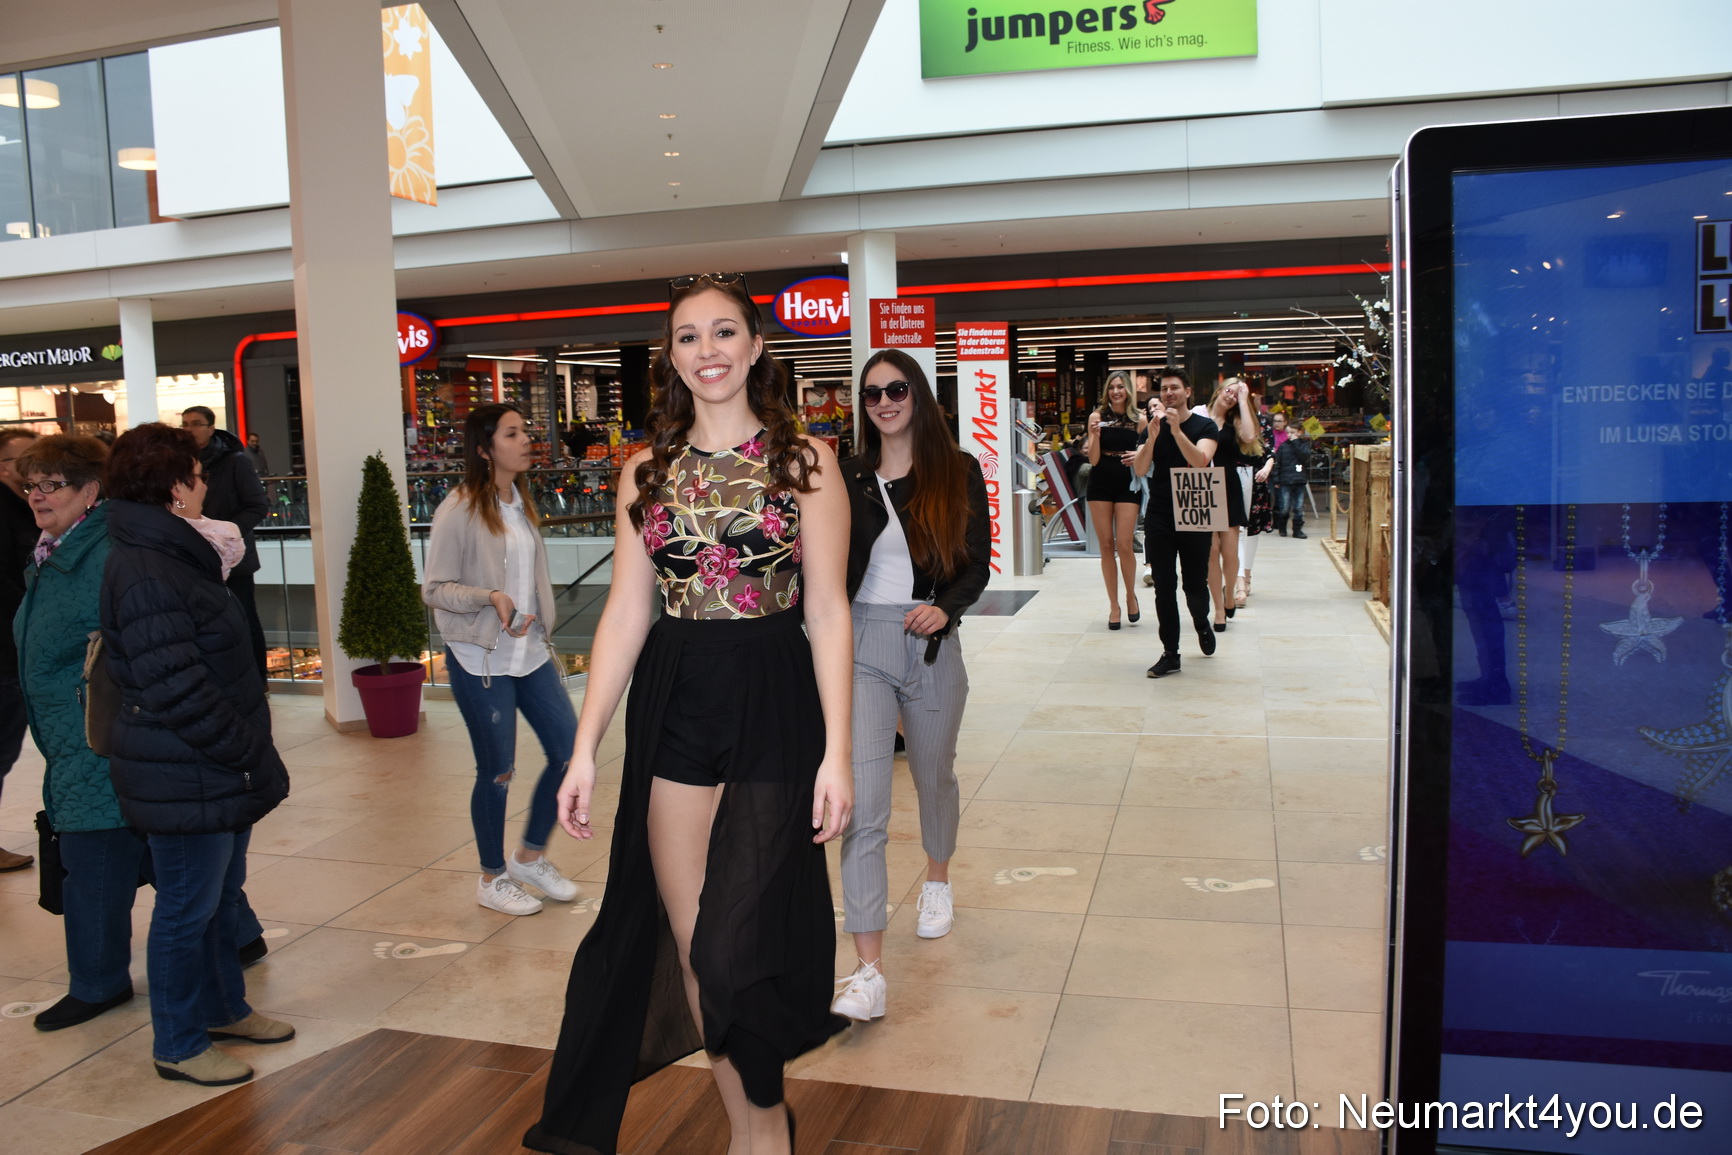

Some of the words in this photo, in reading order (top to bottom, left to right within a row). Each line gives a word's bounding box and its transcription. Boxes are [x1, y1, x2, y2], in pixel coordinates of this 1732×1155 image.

[965, 5, 1137, 53] jumpers
[1067, 40, 1114, 54] Fitness.
[1118, 37, 1141, 50] Wie
[1145, 35, 1173, 48] ich's
[1178, 35, 1207, 47] mag.
[1701, 224, 1732, 271] L
[879, 302, 890, 314] Sie
[891, 302, 912, 314] finden
[913, 304, 925, 314] uns
[1701, 284, 1732, 330] L
[880, 317, 887, 329] in
[889, 317, 899, 329] der
[900, 315, 925, 329] Unteren
[884, 332, 922, 344] Ladenstraße
[957, 328, 968, 336] Sie
[969, 328, 992, 336] finden
[967, 337, 980, 346] der
[980, 337, 1006, 346] Oberen
[960, 346, 1005, 355] Ladenstraße
[1562, 383, 1680, 403] ENTDECKEN
[1686, 382, 1715, 399] SIE
[1600, 427, 1621, 443] IM
[1626, 425, 1682, 443] LUISA
[1174, 473, 1220, 490] TALLY-
[1178, 508, 1211, 525] .COM
